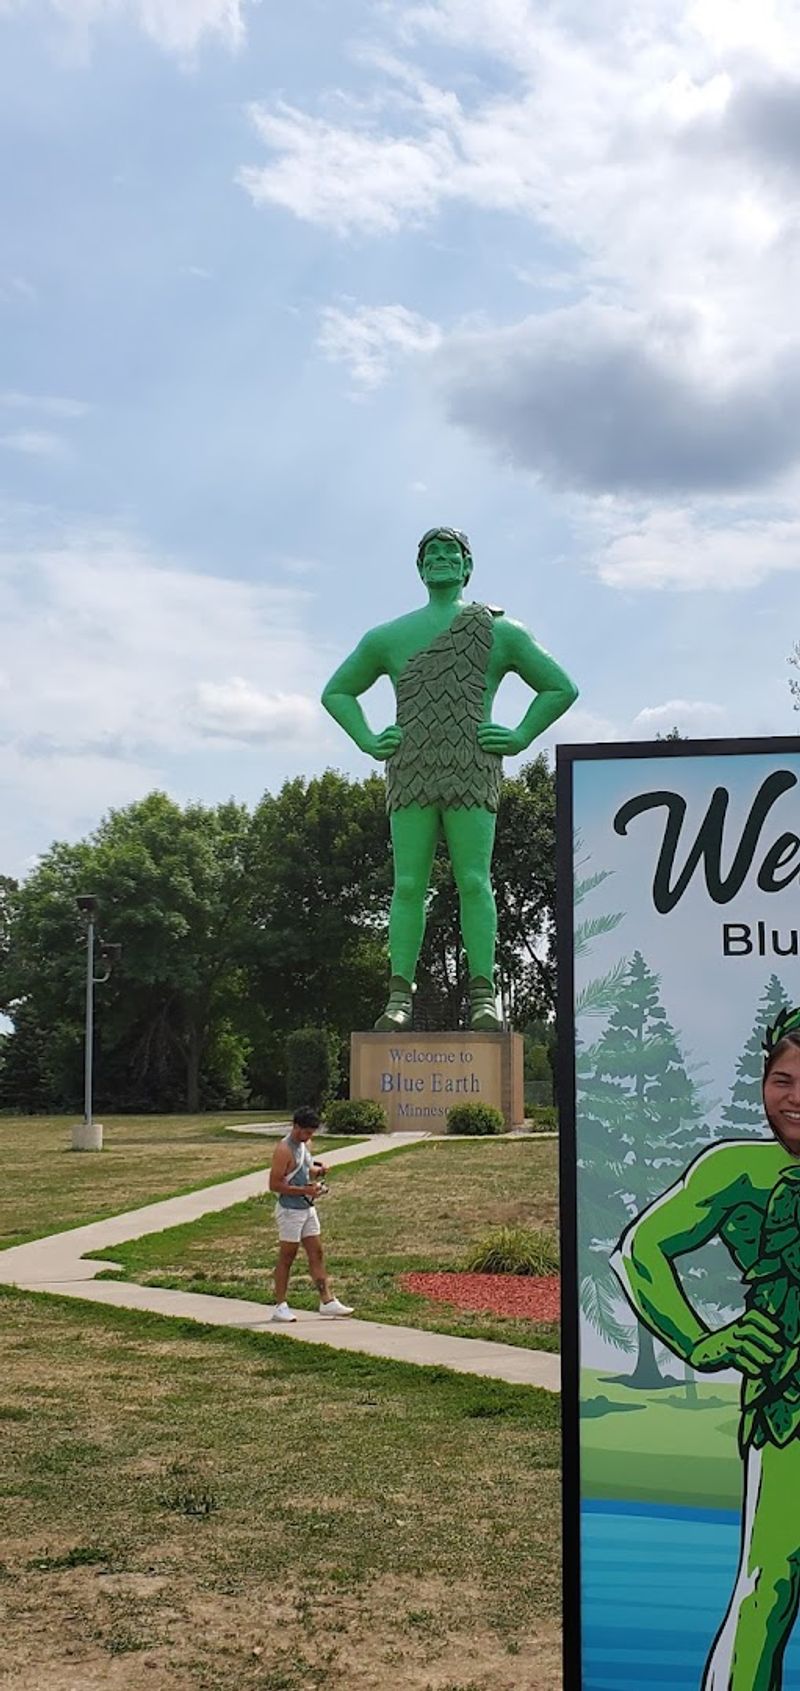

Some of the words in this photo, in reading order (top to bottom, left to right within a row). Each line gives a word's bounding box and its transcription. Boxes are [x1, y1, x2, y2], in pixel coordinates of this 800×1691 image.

[389, 1049, 455, 1063] Welcome
[460, 1050, 473, 1063] to
[381, 1073, 424, 1093] Blue
[432, 1073, 480, 1093] Earth
